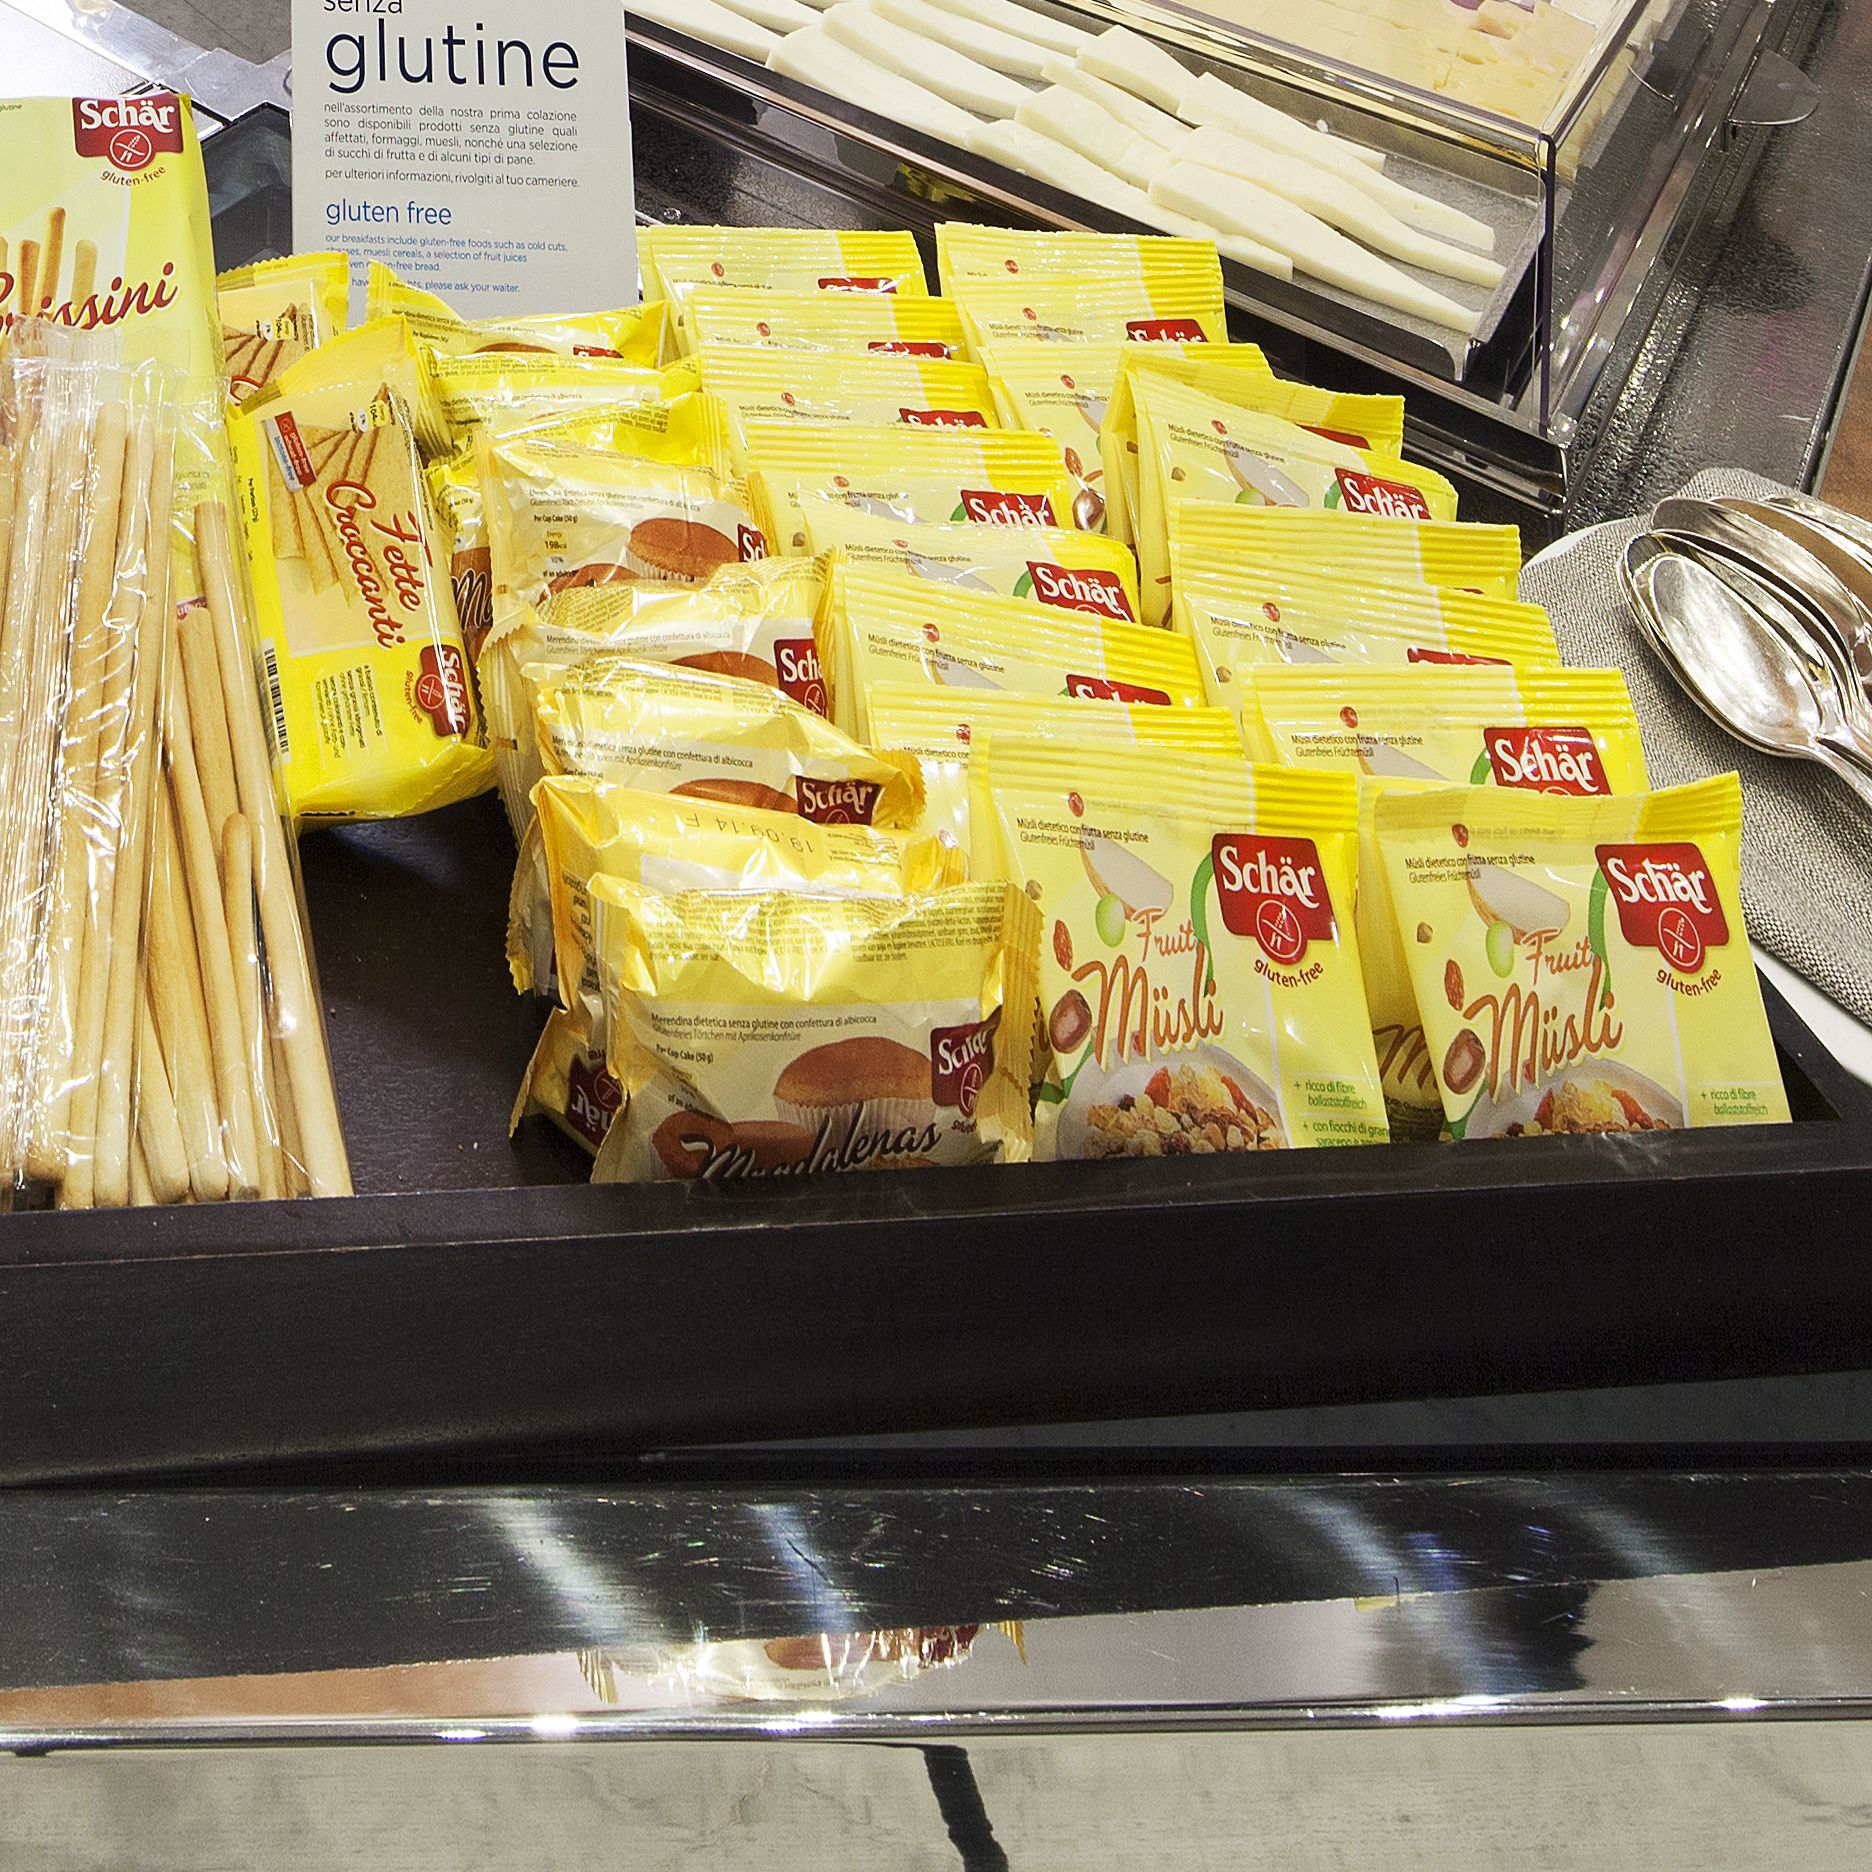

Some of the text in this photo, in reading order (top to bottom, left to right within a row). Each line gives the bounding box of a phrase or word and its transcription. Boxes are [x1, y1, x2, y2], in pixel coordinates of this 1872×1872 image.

[326, 18, 580, 94] glutine
[79, 98, 176, 133] Schär
[324, 102, 577, 121] nell'assortimento della nostra prima colazione
[324, 118, 578, 138] sono disponibili prodotti senza glutine quali
[325, 131, 578, 152] affettati, formaggi, muesli, nonché una selezione
[324, 147, 536, 166] di succhi di frutta e di alcuni tipi di pane.
[100, 165, 167, 187] gluten-free
[325, 169, 342, 179] per
[344, 168, 385, 180] ulteriori
[386, 169, 454, 184] informazioni,
[455, 172, 494, 186] rivolgiti
[495, 173, 504, 184] al
[506, 175, 524, 185] tuo
[326, 198, 452, 225] gluten free
[326, 234, 546, 250] our breakfasts include gluten-free foods such as cold
[363, 248, 390, 258] muesli
[433, 250, 472, 260] selection
[473, 251, 483, 260] of
[484, 251, 501, 261] fruit
[503, 253, 528, 263] juices
[425, 281, 452, 291] please
[455, 282, 469, 290] ask
[471, 283, 490, 293] your
[1343, 477, 1428, 520] Schär
[325, 480, 406, 650] Croccanti
[370, 510, 433, 612] Fette
[1036, 566, 1122, 612] Schär
[404, 670, 423, 725] gluten-free
[441, 649, 466, 740] Schär
[663, 750, 753, 768] con confettura di albicocca
[1494, 734, 1600, 794] Schär
[1037, 820, 1069, 833] dietetico
[1103, 830, 1122, 840] senza
[1123, 830, 1149, 843] glutine
[1425, 856, 1456, 868] dietetico
[1487, 855, 1508, 865] senza
[1509, 853, 1535, 868] glutine
[1219, 846, 1321, 910] Schär
[1606, 857, 1714, 914] Schär
[1132, 906, 1198, 963] Fruit
[1521, 927, 1596, 986] Fruit
[1253, 958, 1324, 988] gluten-free
[1655, 967, 1722, 997] gluten-free
[1071, 939, 1224, 1066] Müsli
[651, 1013, 877, 1032] Merendina dietetica senza glutine con confettura di albicocca
[1462, 952, 1623, 1098] Müsli
[680, 1049, 695, 1061] Cake
[1305, 1079, 1325, 1092] ricco
[1312, 1122, 1328, 1132] con
